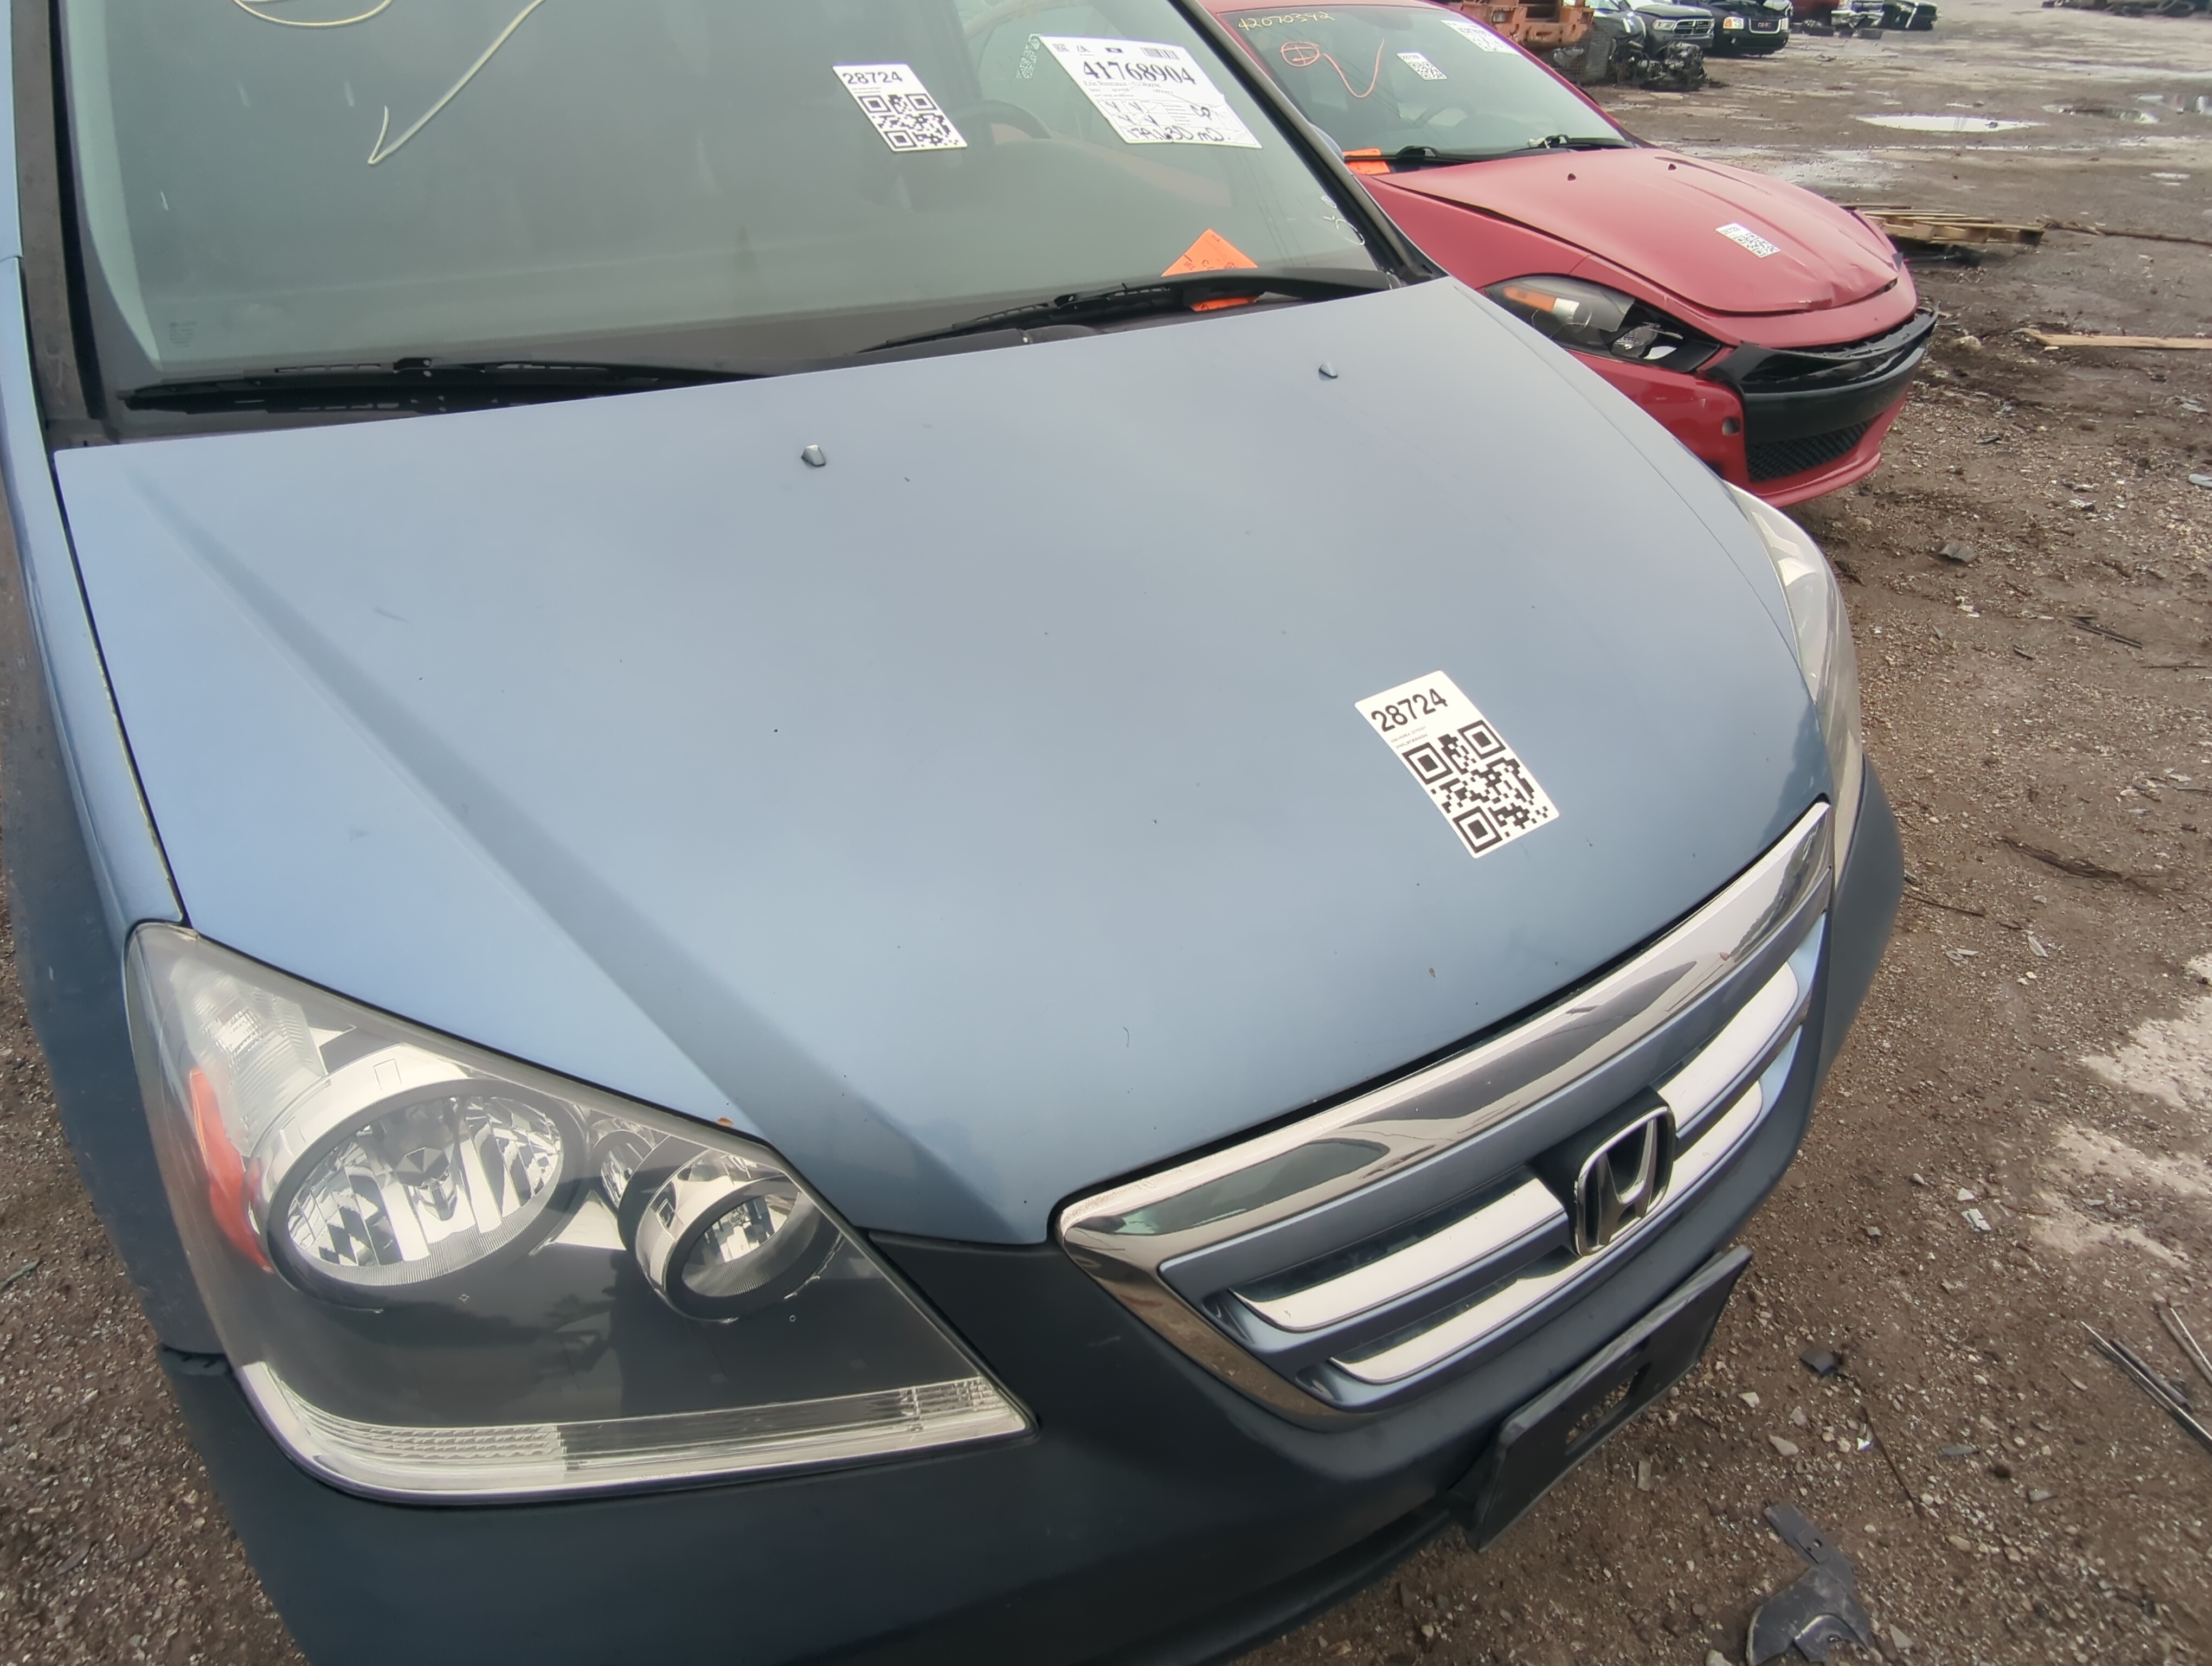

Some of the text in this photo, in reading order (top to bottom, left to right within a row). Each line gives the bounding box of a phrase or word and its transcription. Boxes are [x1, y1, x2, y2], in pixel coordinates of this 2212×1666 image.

[843, 72, 903, 84] 28724
[1083, 61, 1195, 85] 41768904
[1371, 688, 1448, 732] 28724
